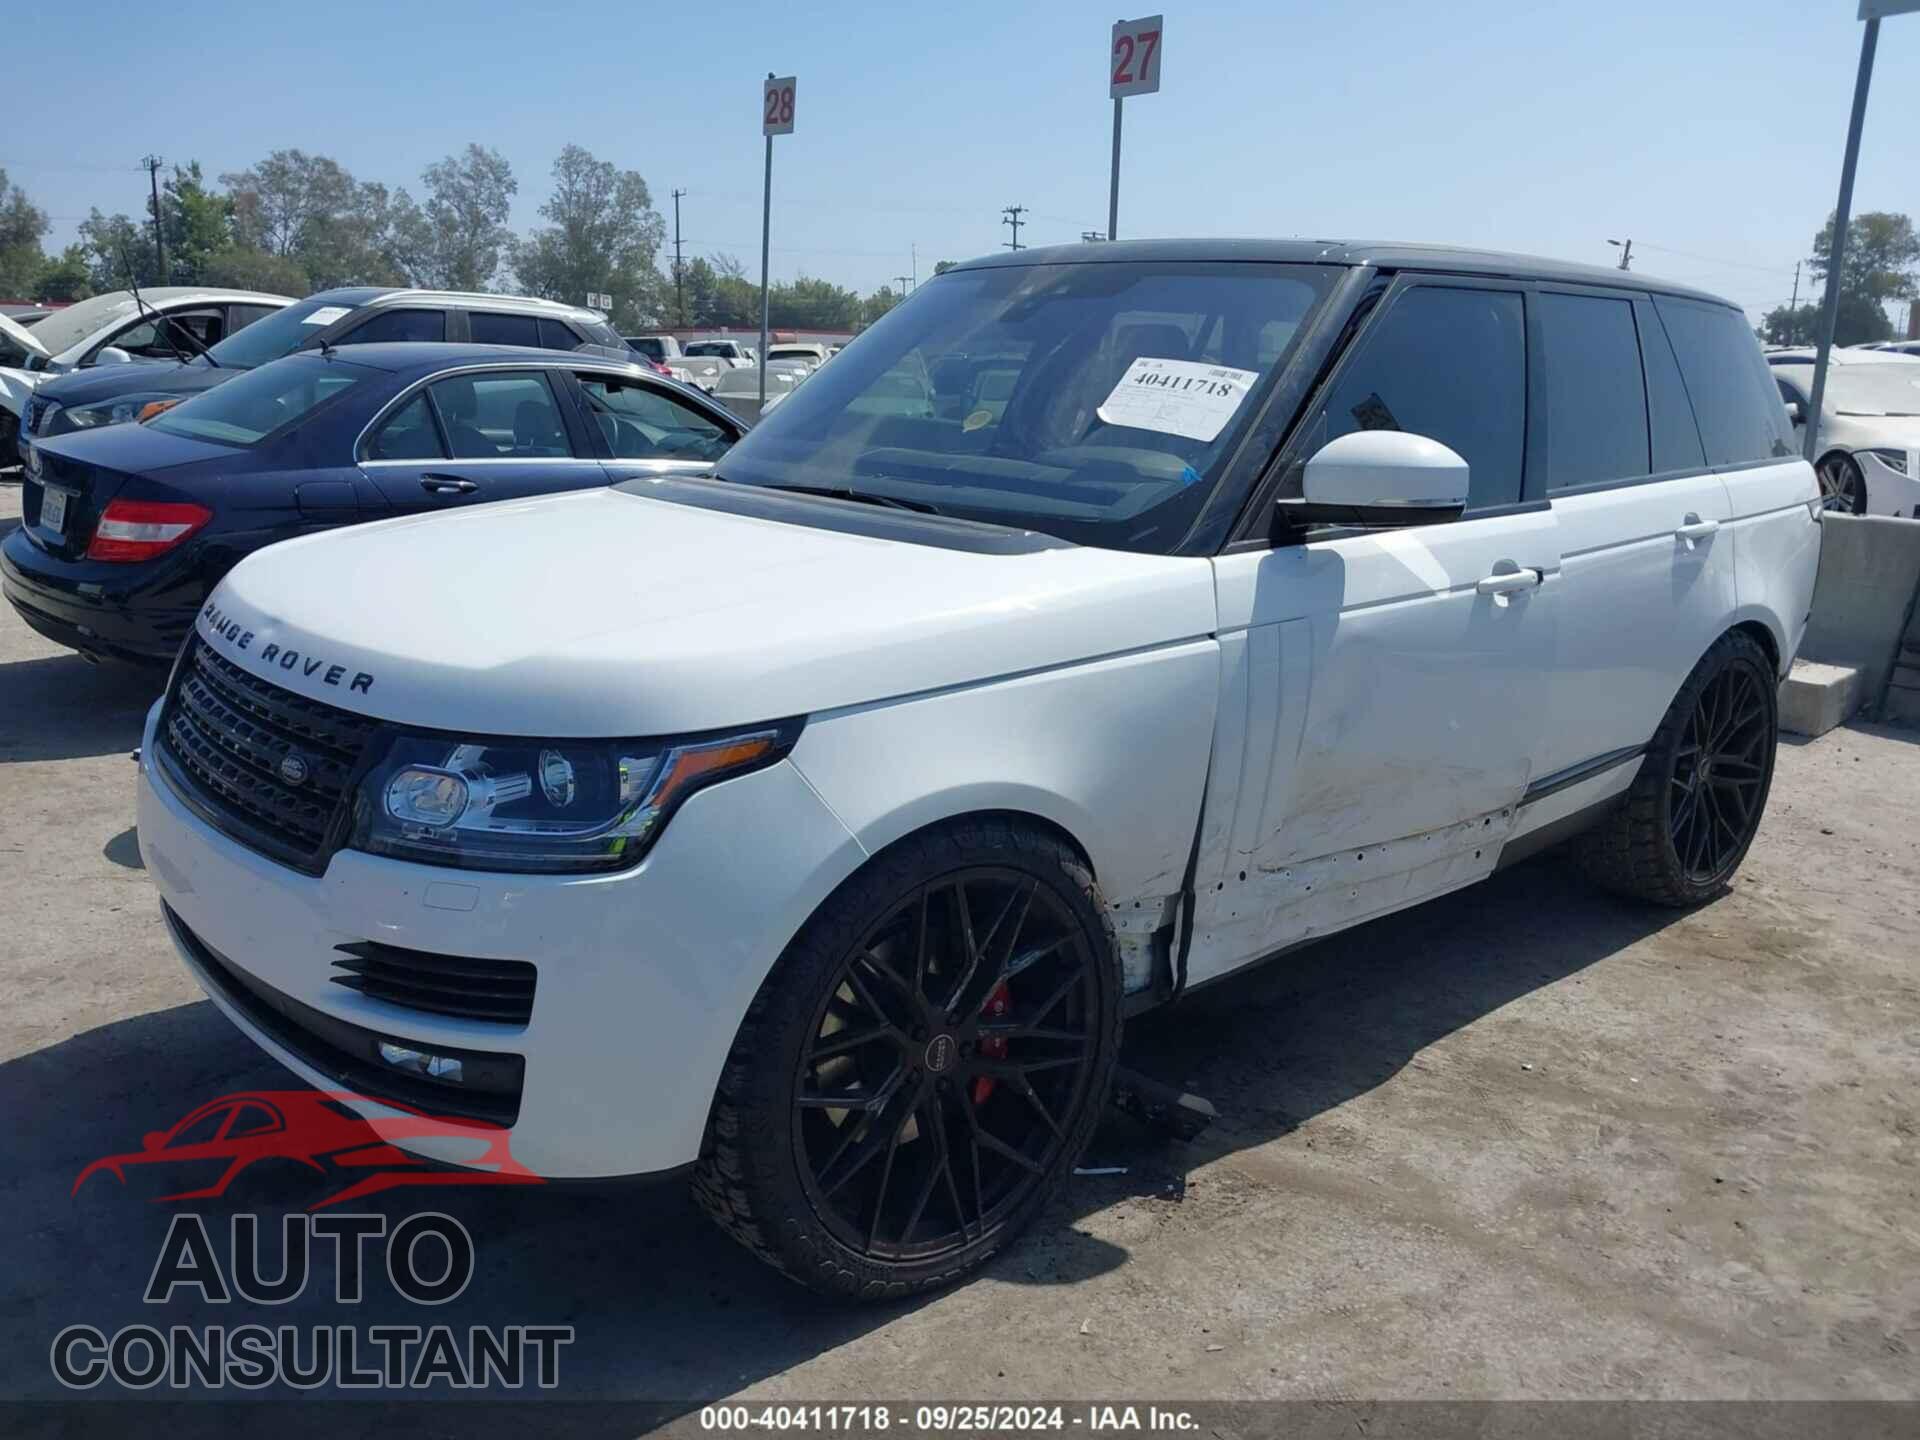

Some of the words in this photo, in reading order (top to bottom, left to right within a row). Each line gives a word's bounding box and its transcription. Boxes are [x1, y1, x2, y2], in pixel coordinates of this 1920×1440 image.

[1112, 31, 1160, 84] 27
[764, 87, 794, 125] 28
[1134, 371, 1233, 398] 40411718
[204, 602, 255, 650] RANGE
[261, 643, 375, 695] ROVER
